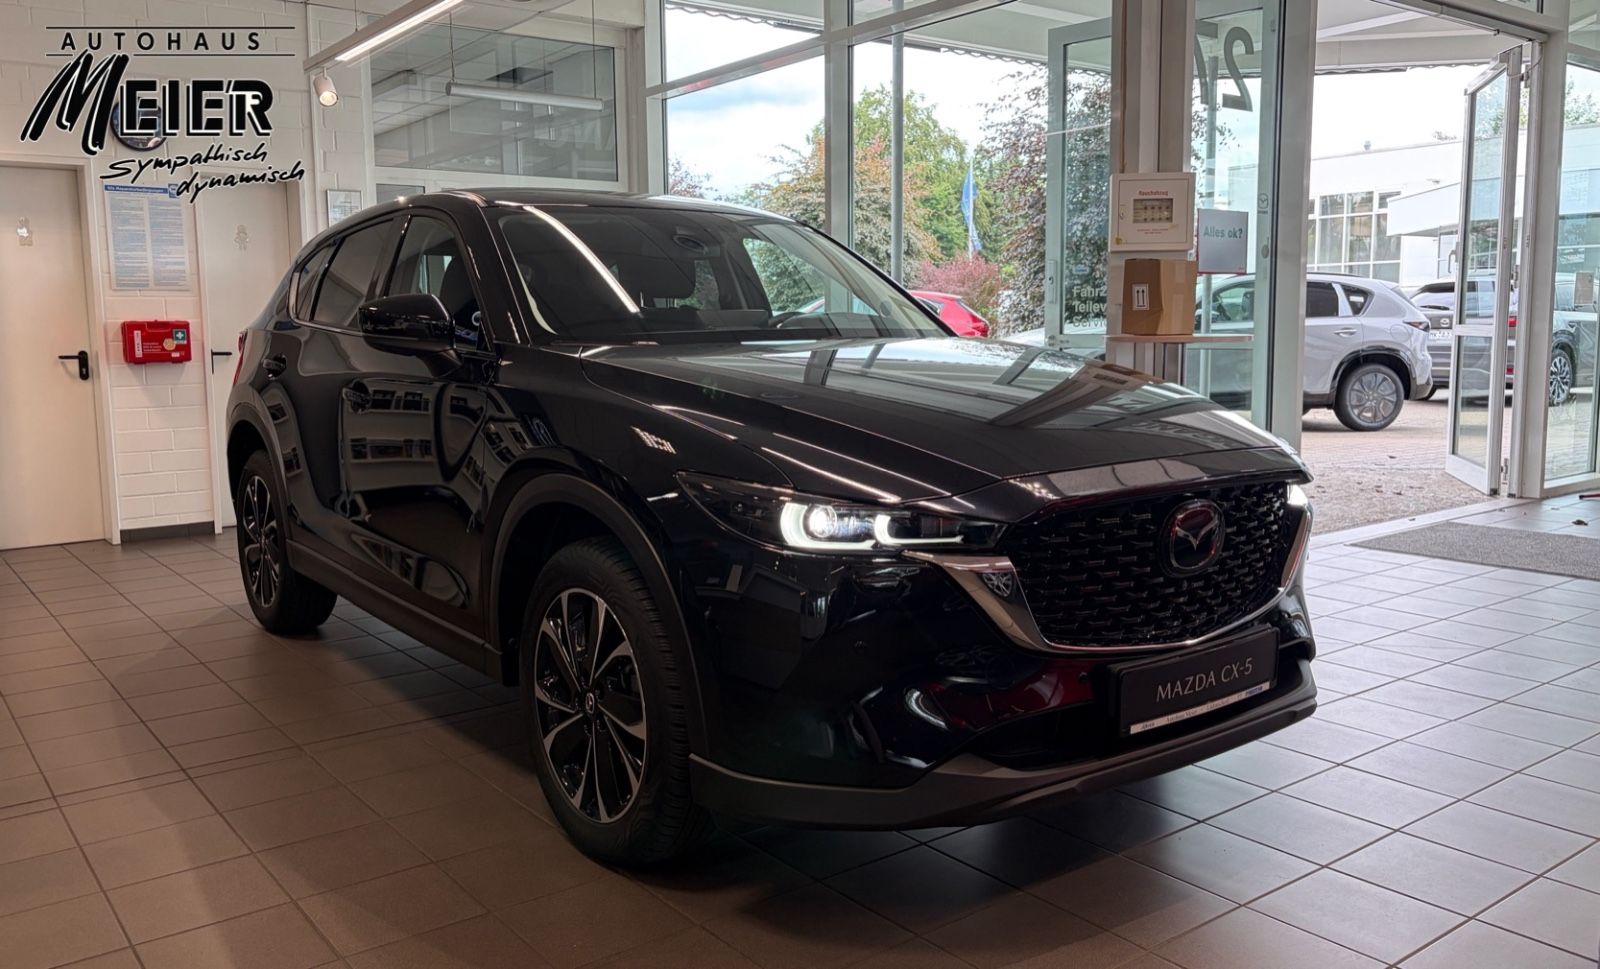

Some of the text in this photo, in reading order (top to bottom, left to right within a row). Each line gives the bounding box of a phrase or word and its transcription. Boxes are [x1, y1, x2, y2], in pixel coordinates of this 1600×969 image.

[1203, 226, 1243, 239] Alles ok?
[1156, 671, 1216, 702] MAZDA
[1221, 657, 1253, 682] CX-5
